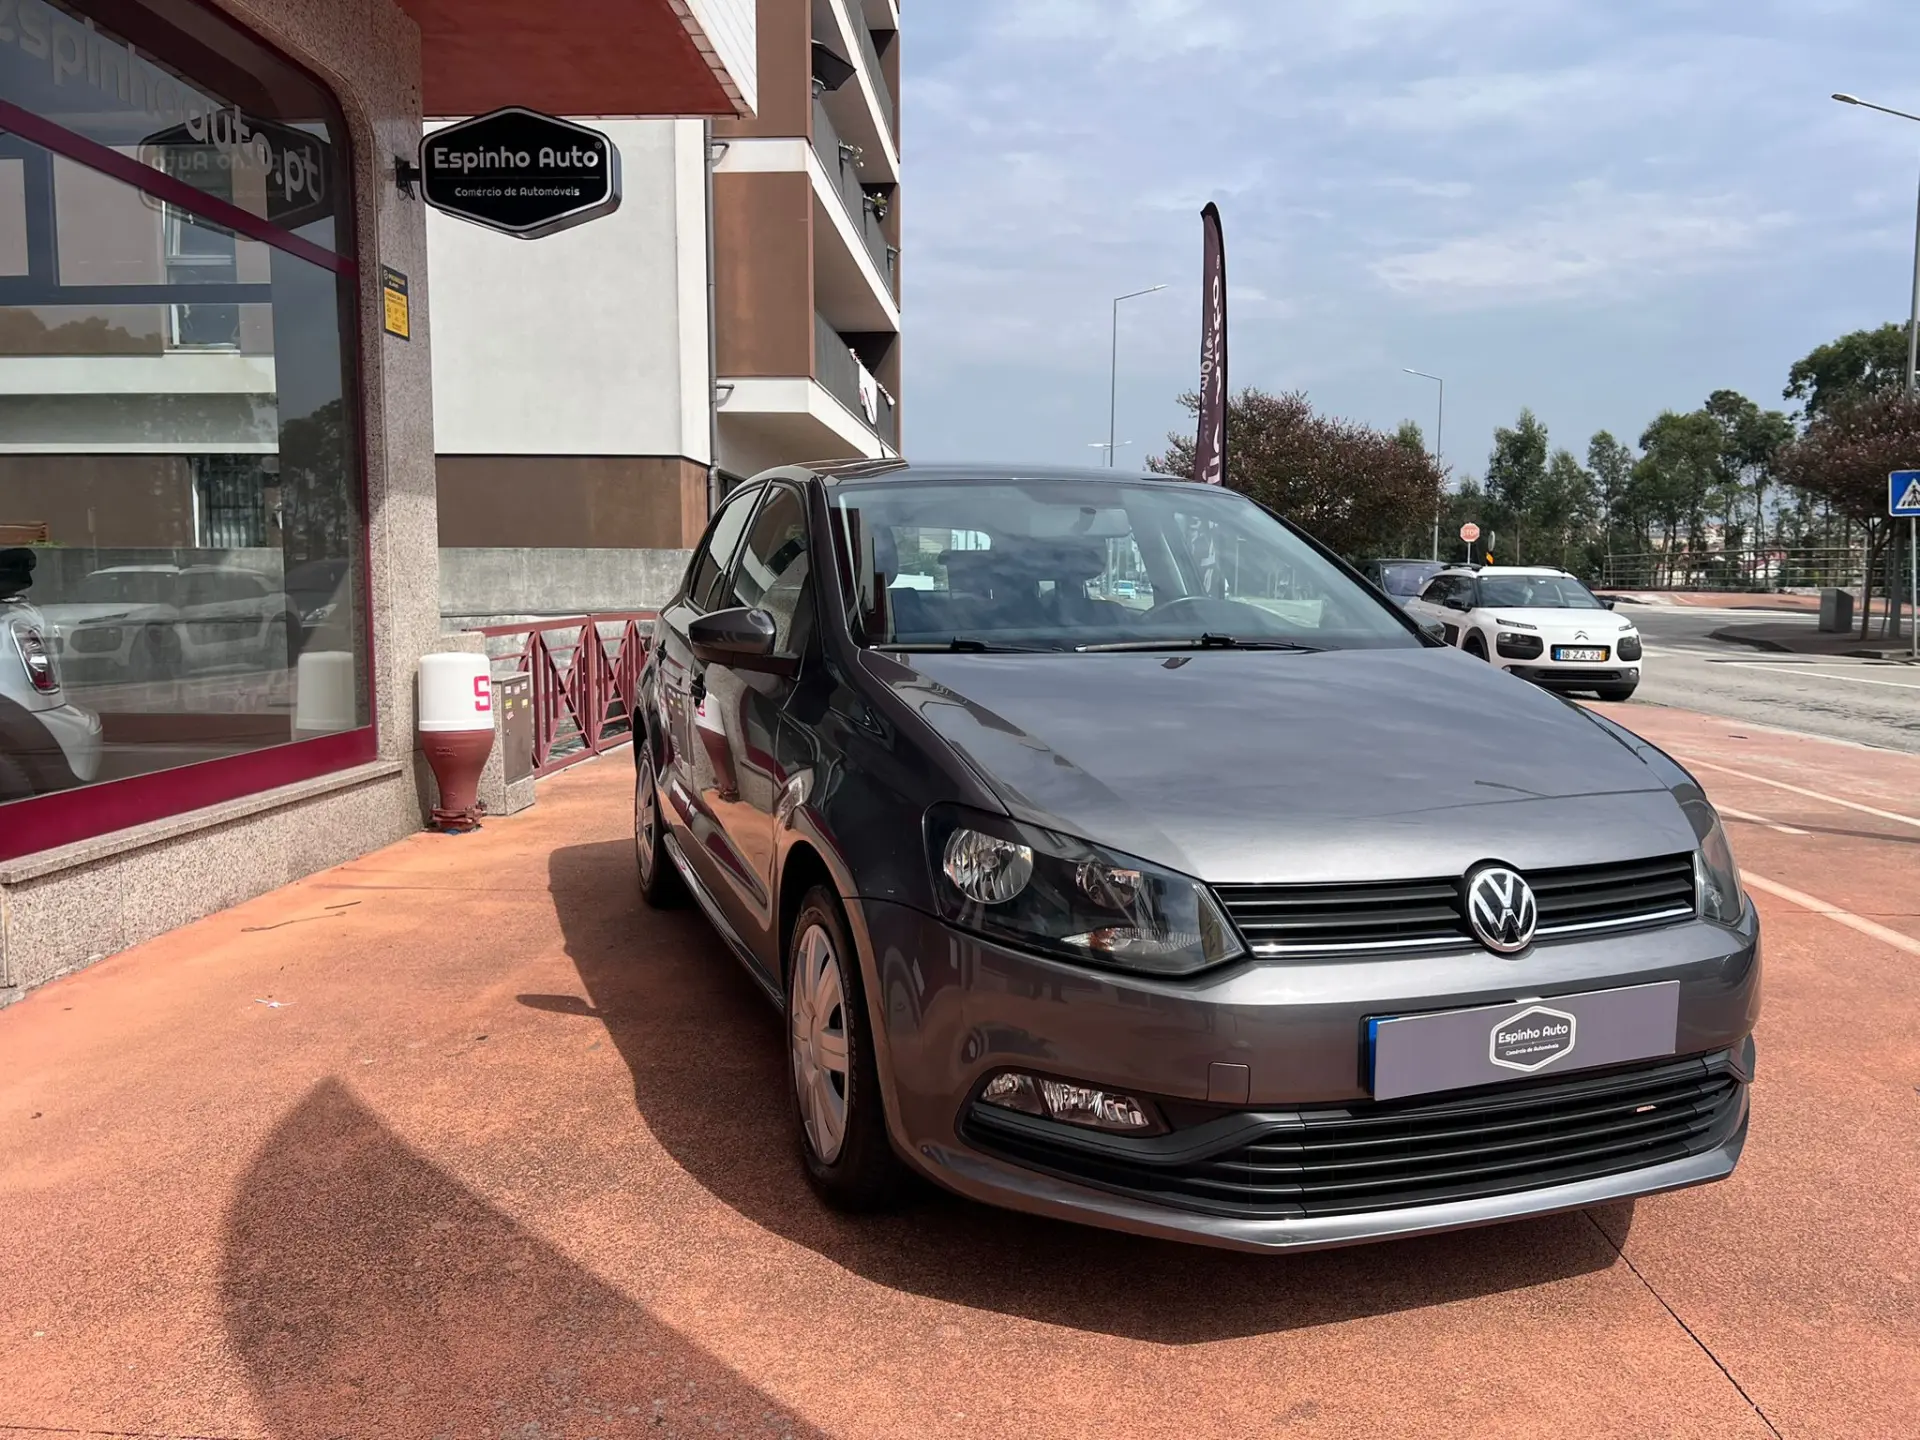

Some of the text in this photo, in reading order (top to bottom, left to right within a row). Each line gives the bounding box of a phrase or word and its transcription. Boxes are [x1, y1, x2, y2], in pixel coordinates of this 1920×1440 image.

[434, 145, 599, 175] Espinho Auto
[454, 185, 580, 197] Comércio de Automóveis
[1498, 1023, 1569, 1044] Espinho Auto
